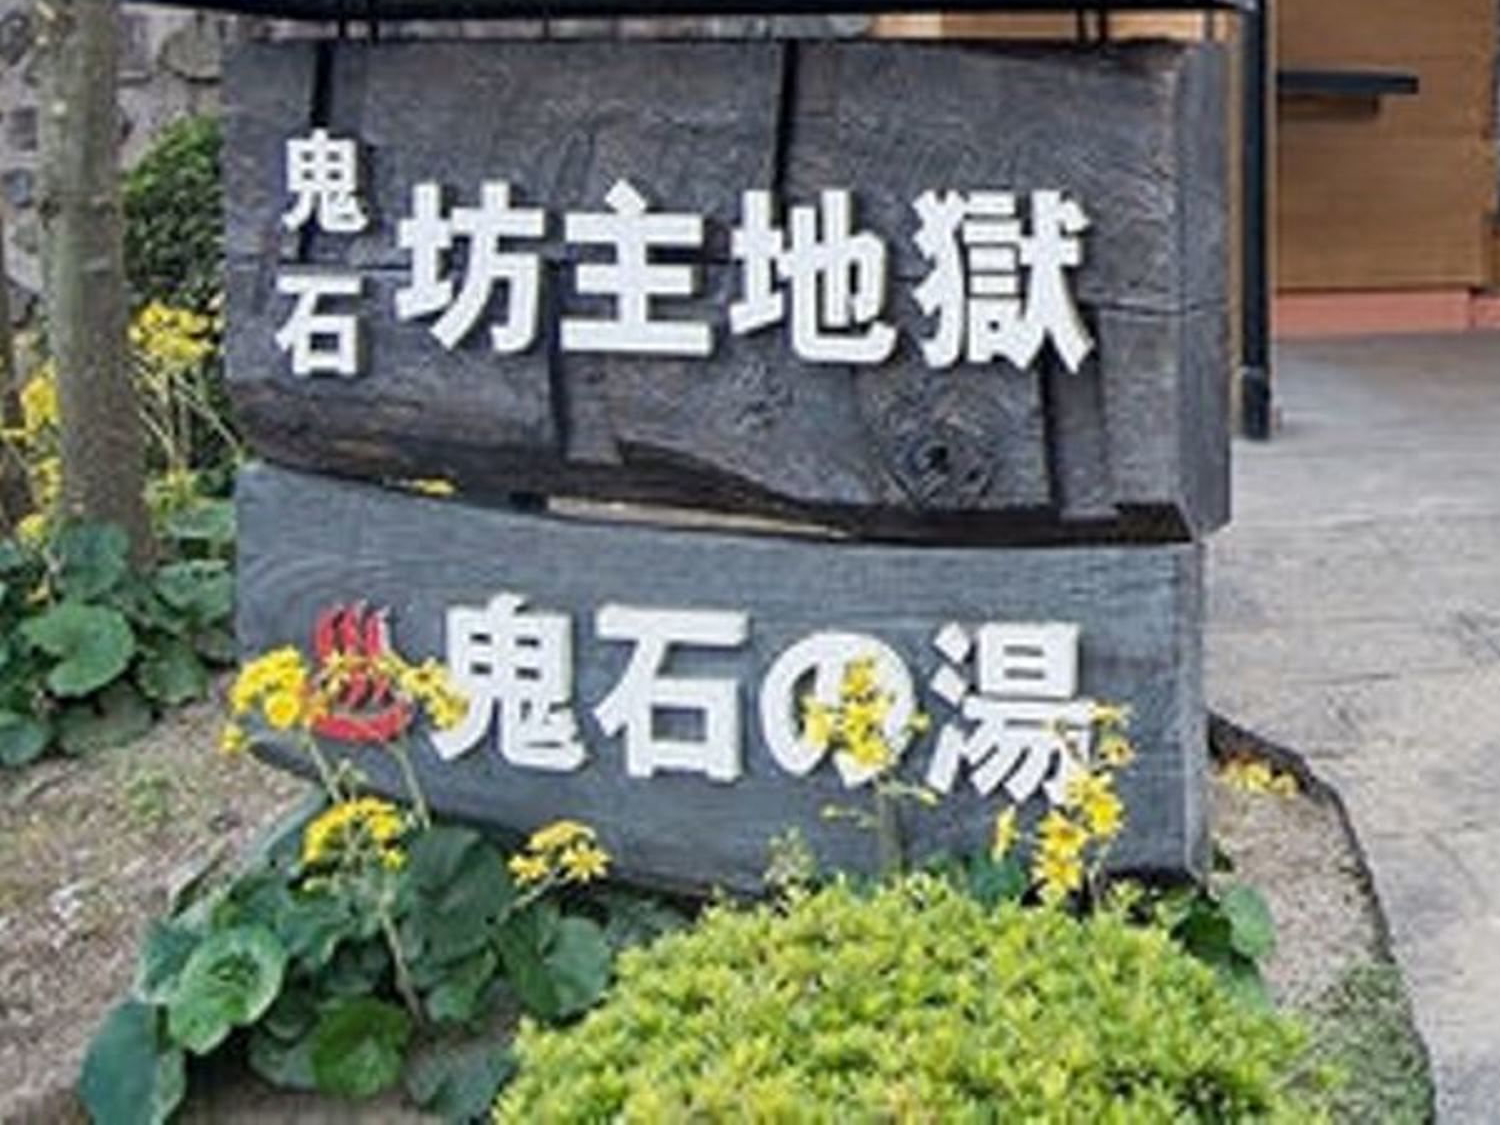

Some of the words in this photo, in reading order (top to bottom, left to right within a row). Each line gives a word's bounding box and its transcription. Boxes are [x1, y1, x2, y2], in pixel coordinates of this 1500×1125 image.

[276, 129, 367, 374] 鬼石
[397, 179, 1094, 372] 坊主地獄
[429, 591, 1094, 806] 鬼石の湯
